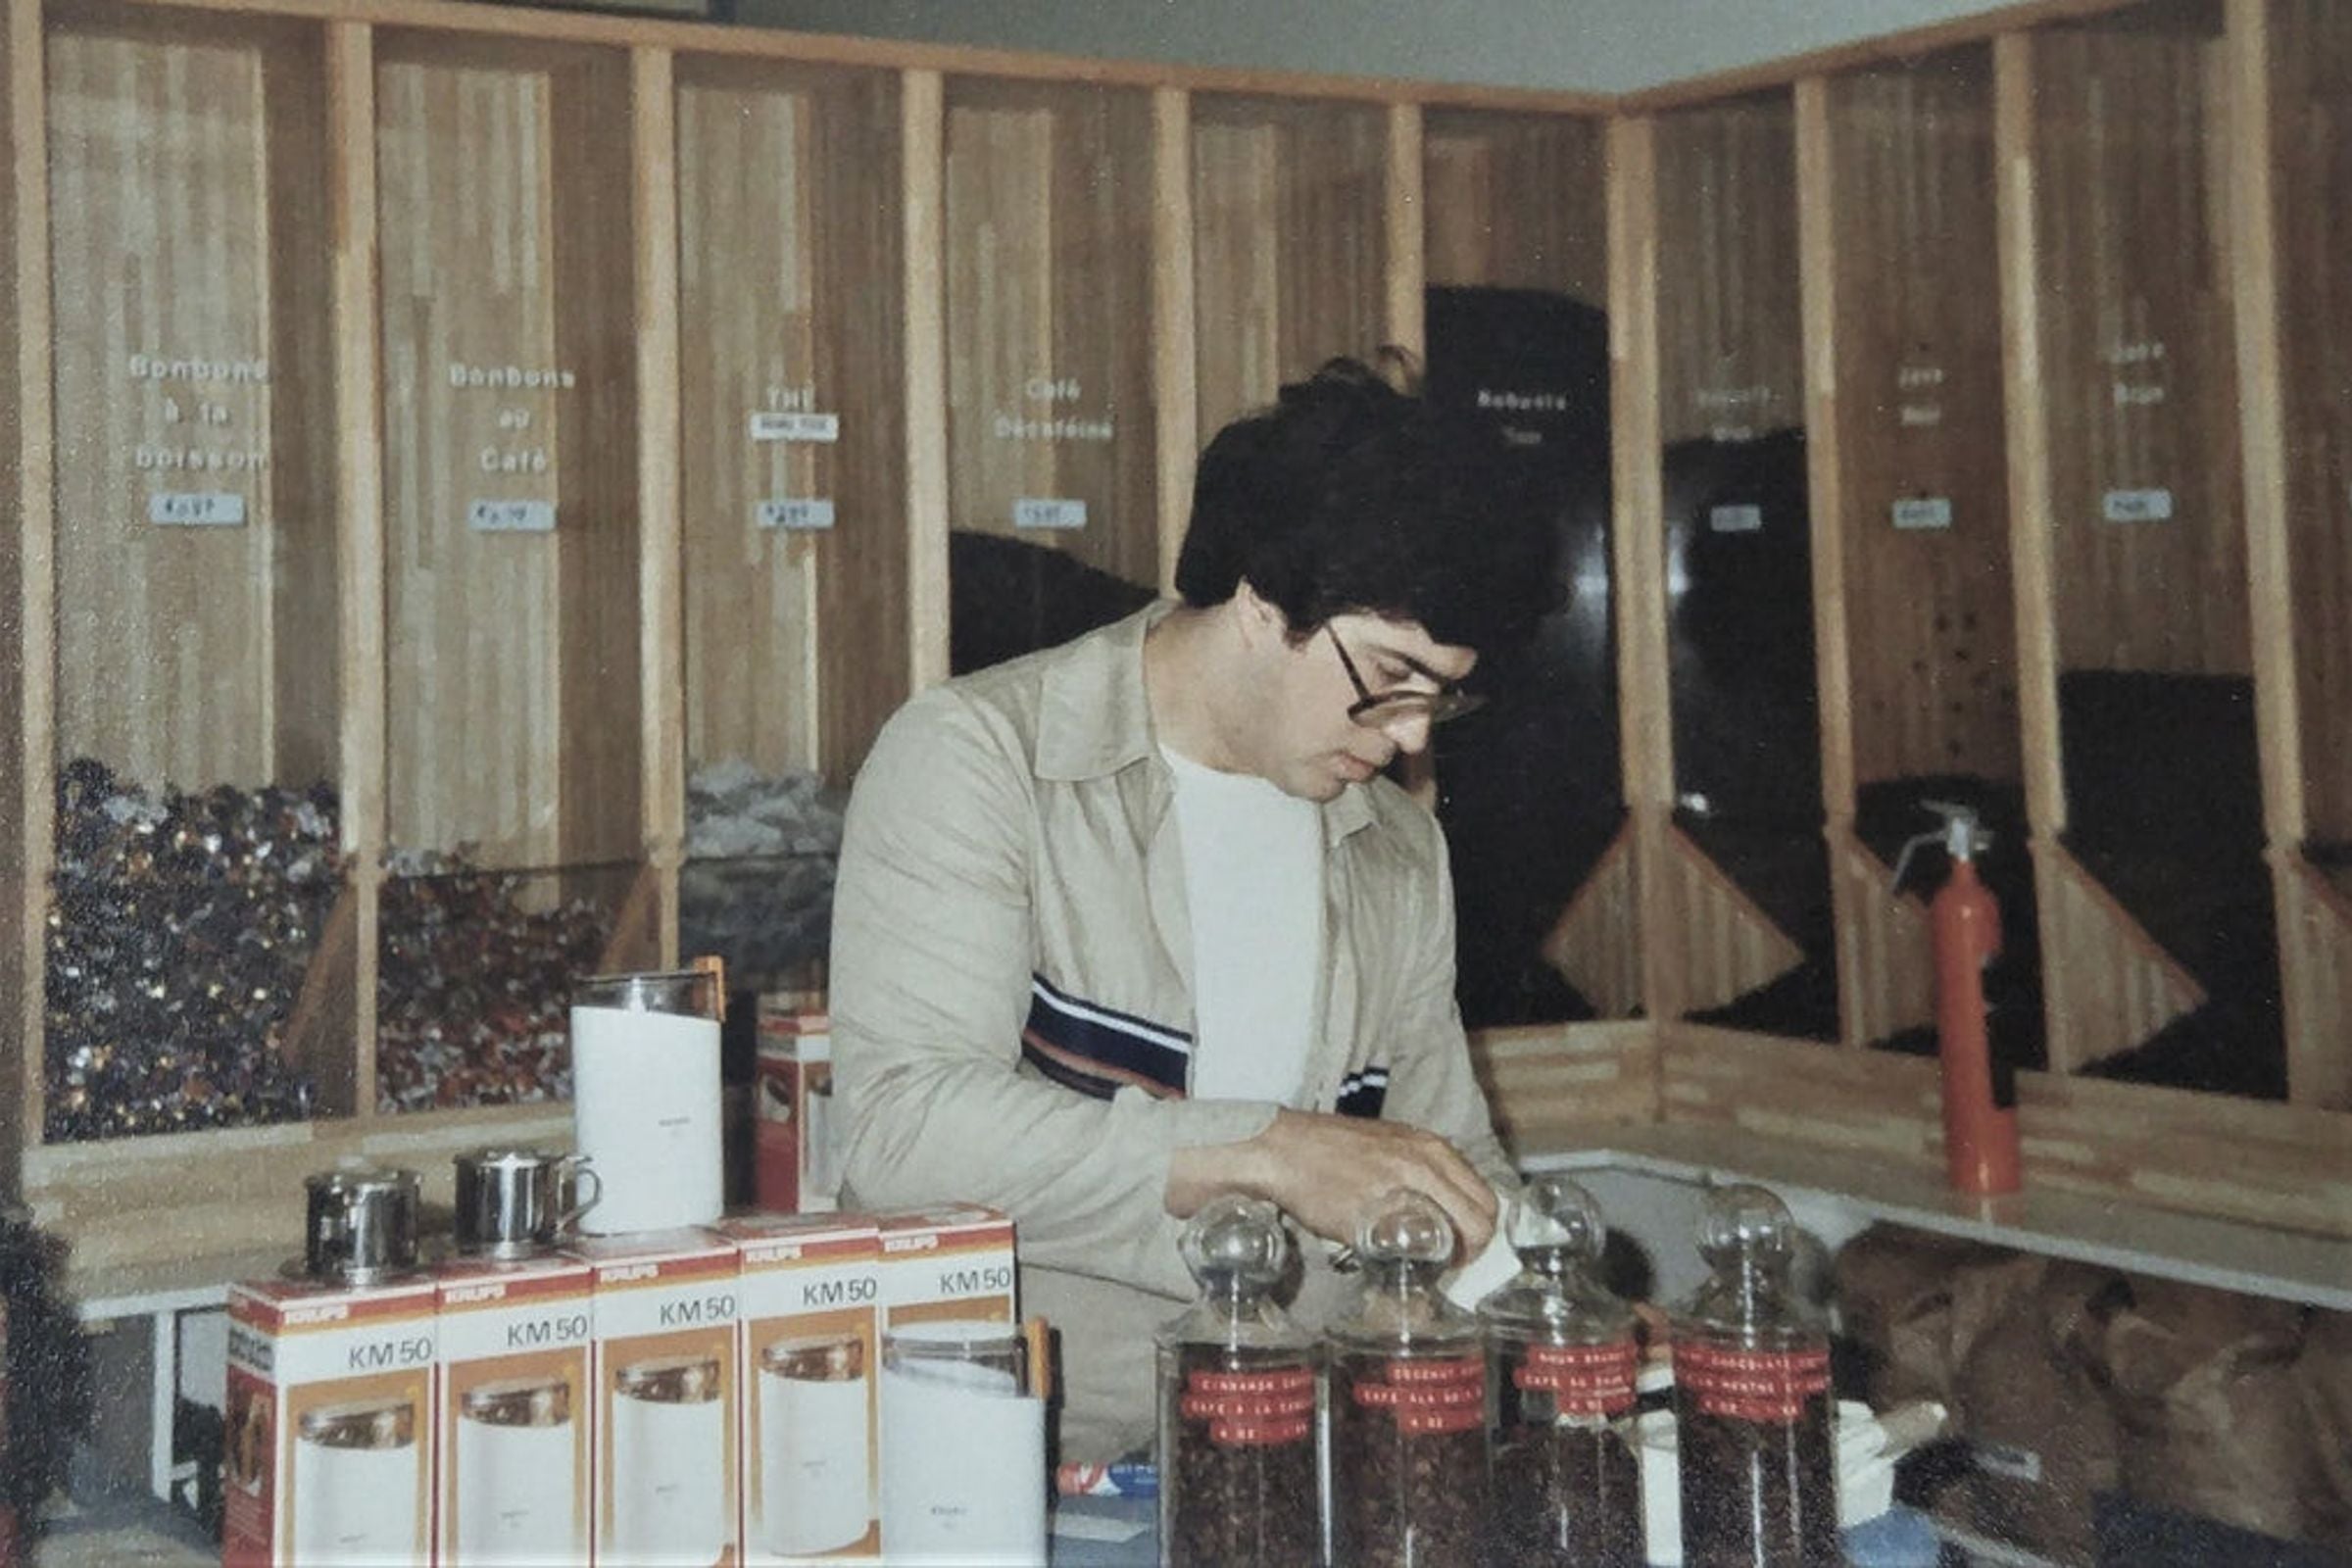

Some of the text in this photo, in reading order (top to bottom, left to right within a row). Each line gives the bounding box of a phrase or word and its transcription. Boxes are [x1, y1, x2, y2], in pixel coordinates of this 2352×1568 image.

[450, 363, 576, 389] Bonbons
[804, 1276, 878, 1305] KM 50
[940, 1266, 1011, 1294] KM 50
[660, 1294, 735, 1325] KM 50
[507, 1315, 588, 1347] KM 50
[349, 1337, 433, 1368] KM 50
